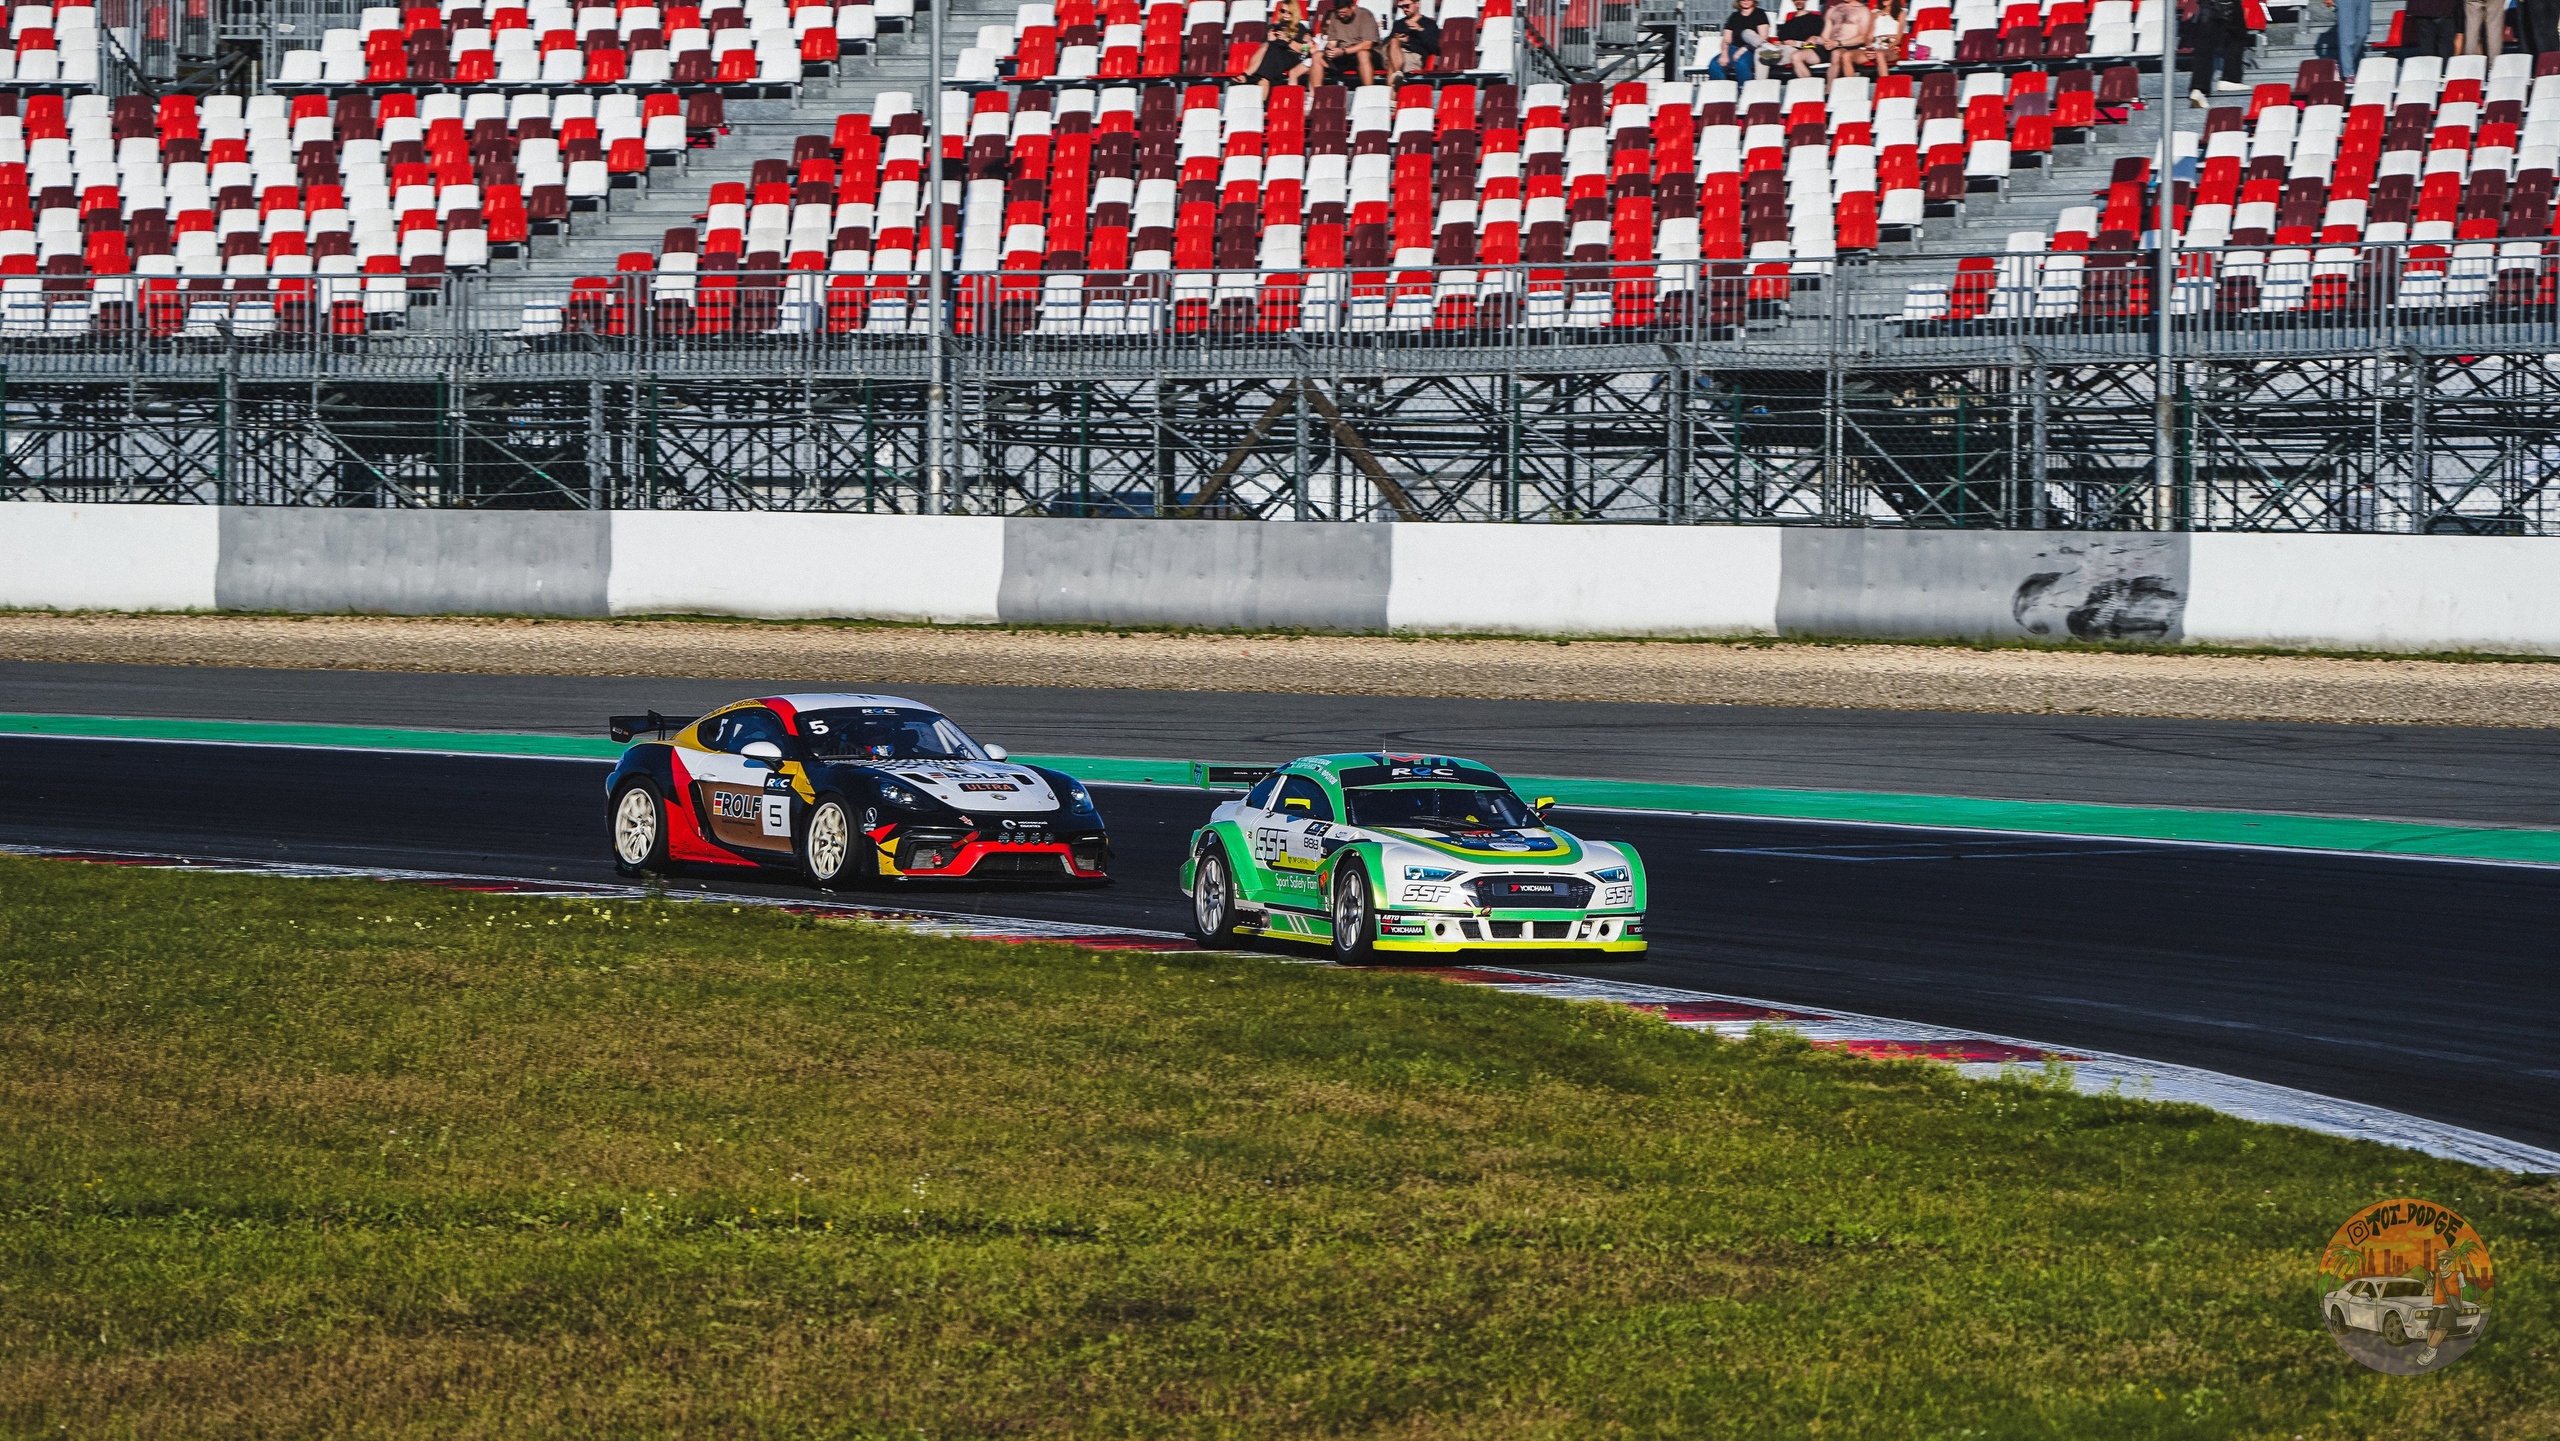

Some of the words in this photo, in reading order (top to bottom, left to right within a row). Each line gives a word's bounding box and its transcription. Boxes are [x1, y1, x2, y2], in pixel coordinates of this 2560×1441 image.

[808, 720, 830, 735] 5
[964, 783, 1014, 791] ULTRA
[721, 792, 763, 820] ROLF
[769, 804, 782, 827] 5
[1255, 827, 1289, 862] SSF
[1304, 837, 1319, 850] 888
[1275, 873, 1289, 891] Sport
[1290, 875, 1306, 893] Safety
[1402, 884, 1451, 902] SSF
[1605, 885, 1632, 905] SSF
[1391, 926, 1424, 934] YOKOHAMA
